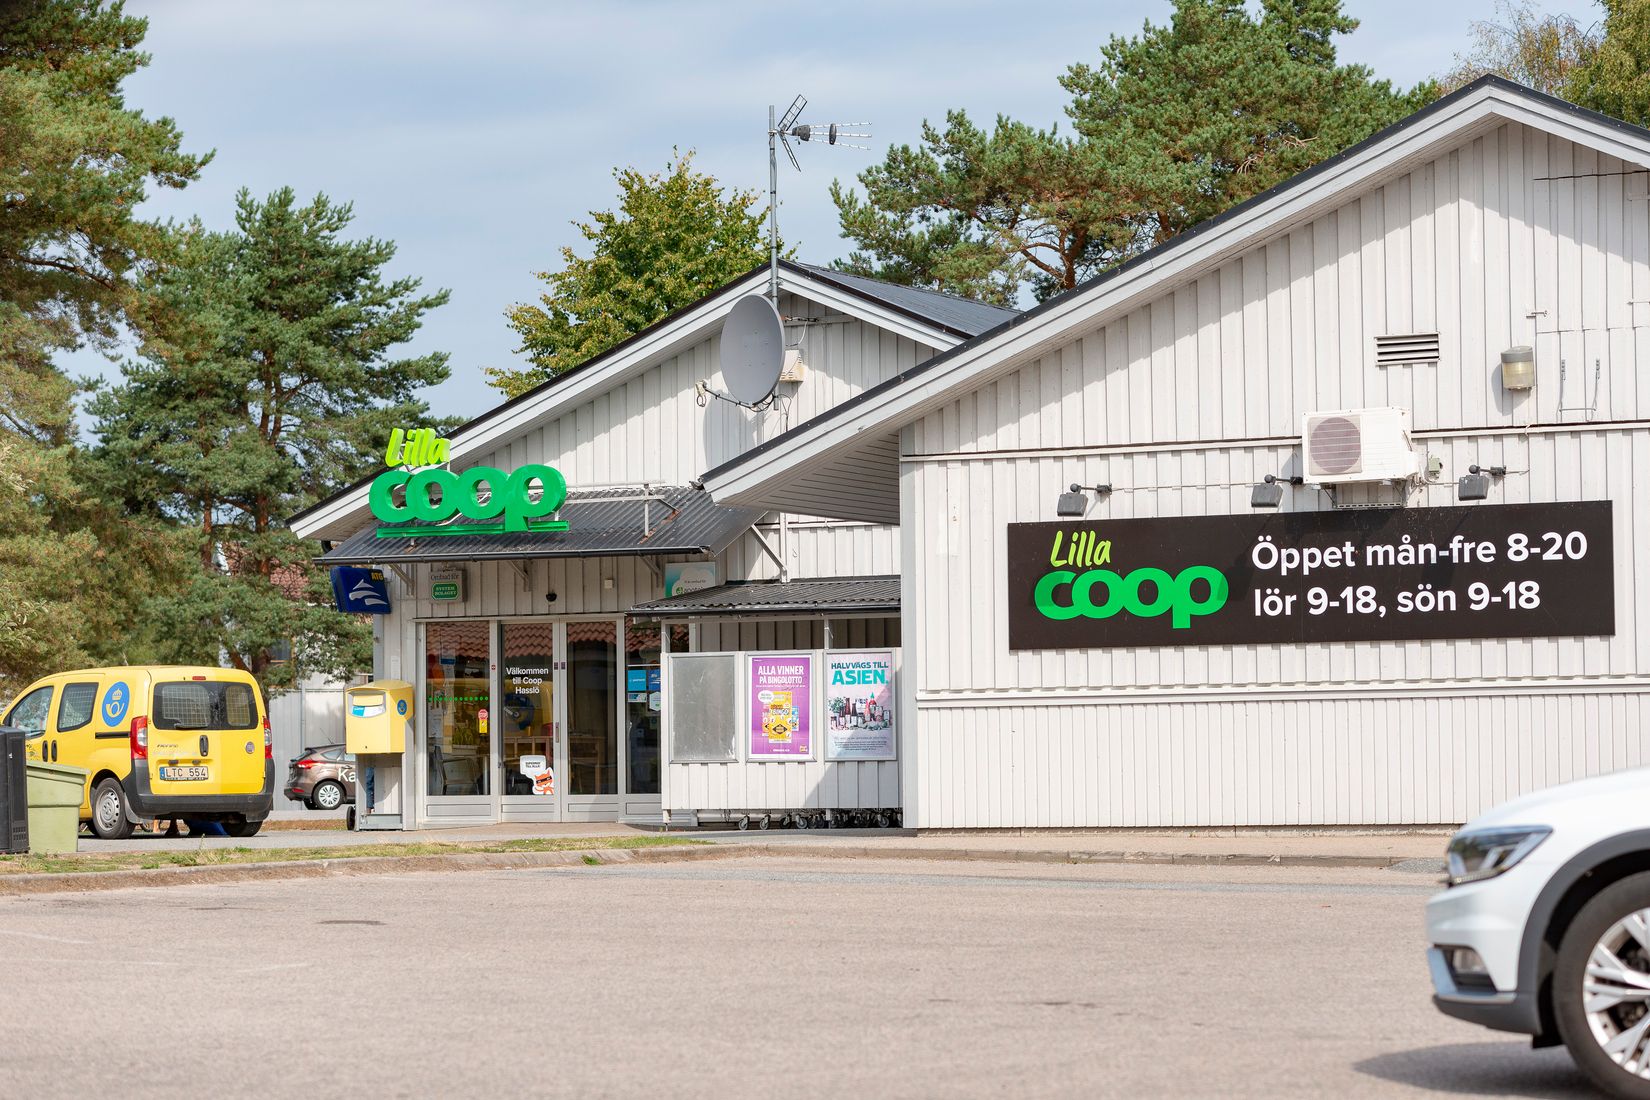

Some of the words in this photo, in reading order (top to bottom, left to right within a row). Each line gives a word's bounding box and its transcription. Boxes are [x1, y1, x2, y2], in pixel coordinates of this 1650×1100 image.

[385, 428, 451, 467] Lilla
[369, 464, 567, 531] coop
[1051, 530, 1111, 568] Lilla
[1252, 534, 1356, 575] Öppet
[1367, 534, 1496, 566] mån-fre
[1507, 530, 1588, 562] 8-20
[1034, 566, 1229, 630] coop
[1254, 588, 1296, 616] lör
[1307, 585, 1387, 618] 9-18,
[1396, 583, 1457, 612] sön
[1468, 580, 1541, 610] 9-18
[506, 667, 549, 675] Välkommen
[758, 665, 776, 675] ALLA
[777, 665, 804, 675] VINNER
[831, 661, 872, 669] HALVVÄGS
[872, 661, 888, 669] TILL
[512, 677, 522, 685] till
[523, 677, 543, 686] Coop
[768, 675, 803, 684] BINGOLOTTO
[831, 669, 889, 686] ASIEN.
[515, 686, 540, 695] Hasslö
[165, 767, 183, 778] LTC
[189, 767, 206, 778] 554
